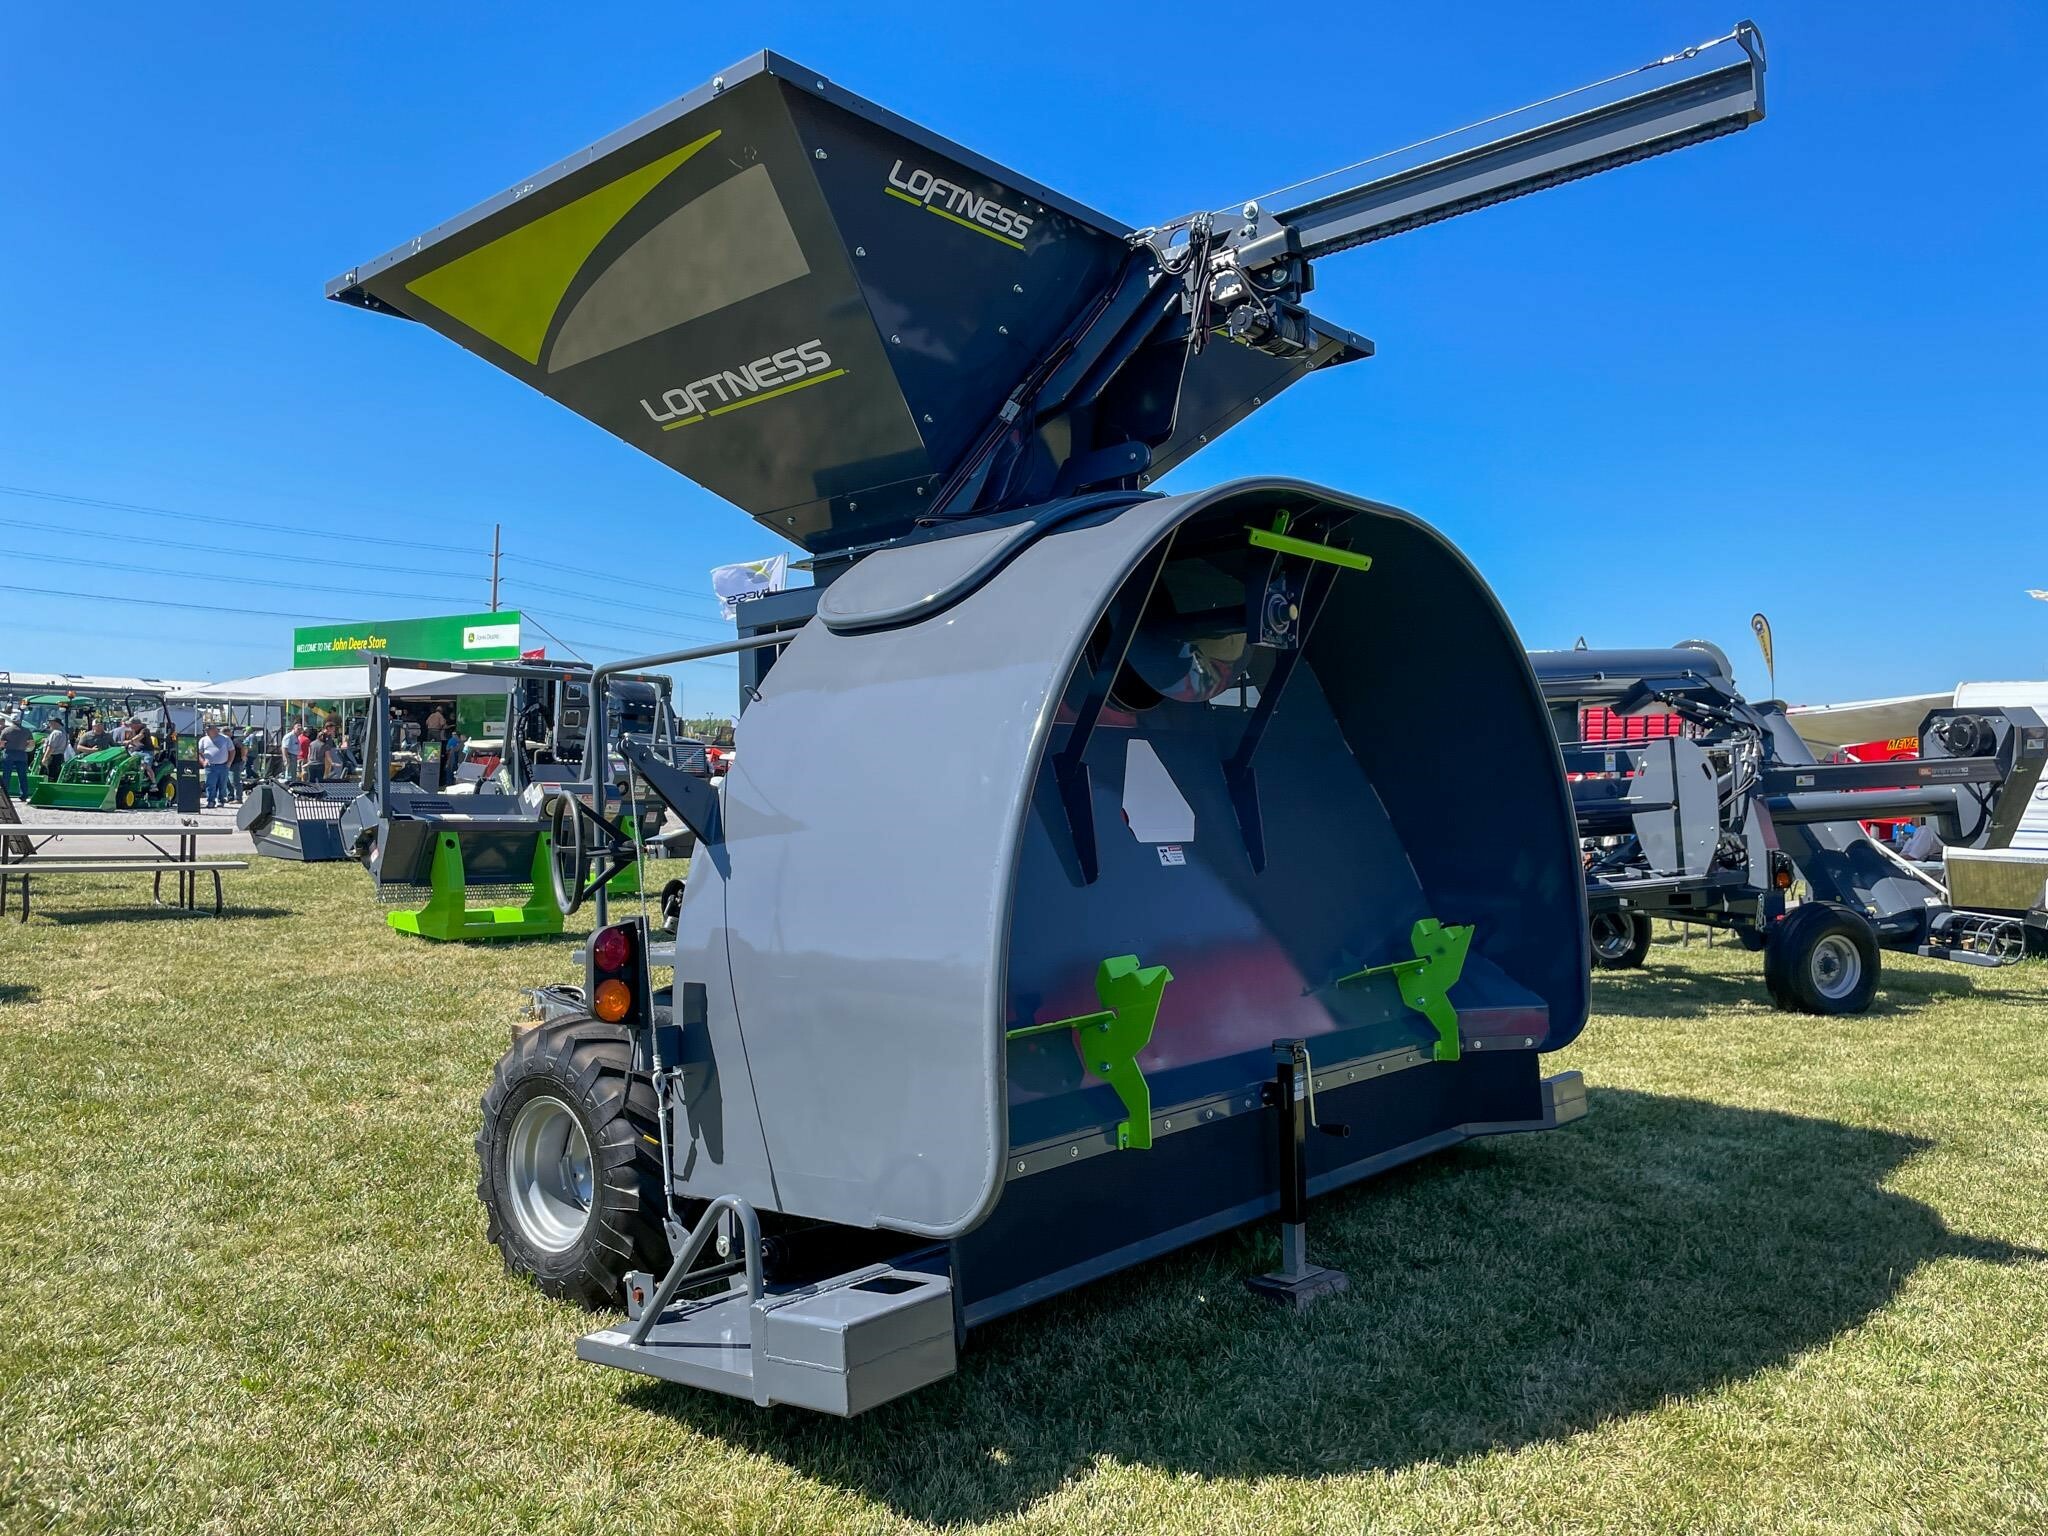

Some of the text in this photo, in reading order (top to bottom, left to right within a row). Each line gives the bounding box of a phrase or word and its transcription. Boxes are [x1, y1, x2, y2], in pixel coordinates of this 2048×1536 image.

[888, 159, 1034, 240] LOFTNESS
[639, 338, 832, 422] LOFTNESS
[296, 643, 316, 653] WELCOME
[323, 642, 332, 651] THE
[332, 638, 347, 651] John
[348, 637, 368, 650] Deere
[367, 635, 387, 649] Store
[1887, 737, 1919, 751] MEYE
